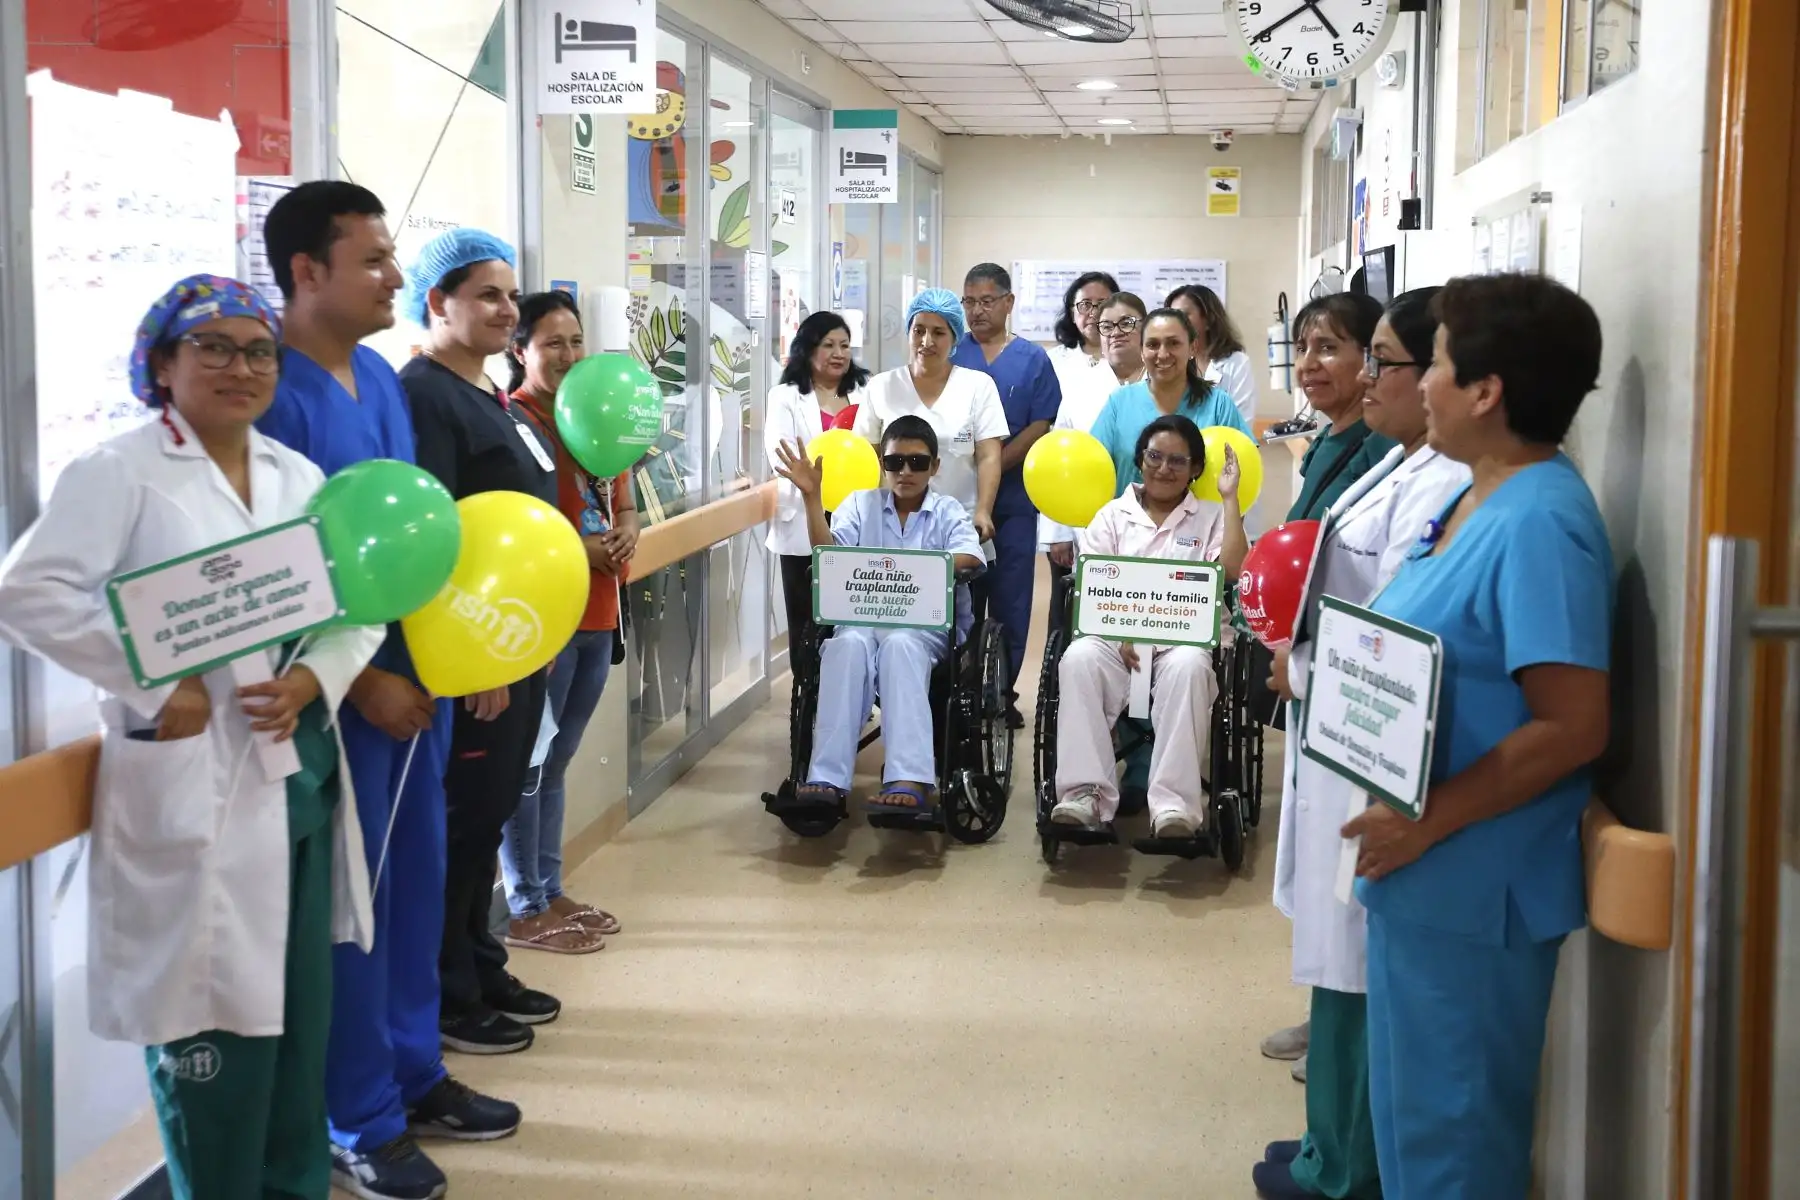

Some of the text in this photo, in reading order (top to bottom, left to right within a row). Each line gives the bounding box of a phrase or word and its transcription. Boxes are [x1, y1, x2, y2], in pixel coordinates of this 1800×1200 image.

[1250, 3, 1261, 15] 9
[1352, 22, 1365, 35] 4
[1281, 47, 1293, 60] 7
[1333, 43, 1344, 56] 5
[1306, 52, 1318, 65] 6
[571, 72, 617, 81] SALA DE
[547, 81, 644, 93] HOSPITALIZACIÓN
[571, 95, 623, 104] ESCOLAR
[852, 567, 912, 582] Cada niño
[1089, 566, 1107, 574] insn
[162, 566, 293, 619] Donar órganos
[845, 580, 920, 595] trasplantado
[850, 594, 915, 606] es un sueño
[1087, 586, 1208, 604] Habla con tu familia
[154, 580, 312, 643] es un acto de amor
[854, 605, 907, 619] cumplido
[1096, 601, 1197, 617] sobre tu decisión
[1101, 614, 1190, 630] de ser donante
